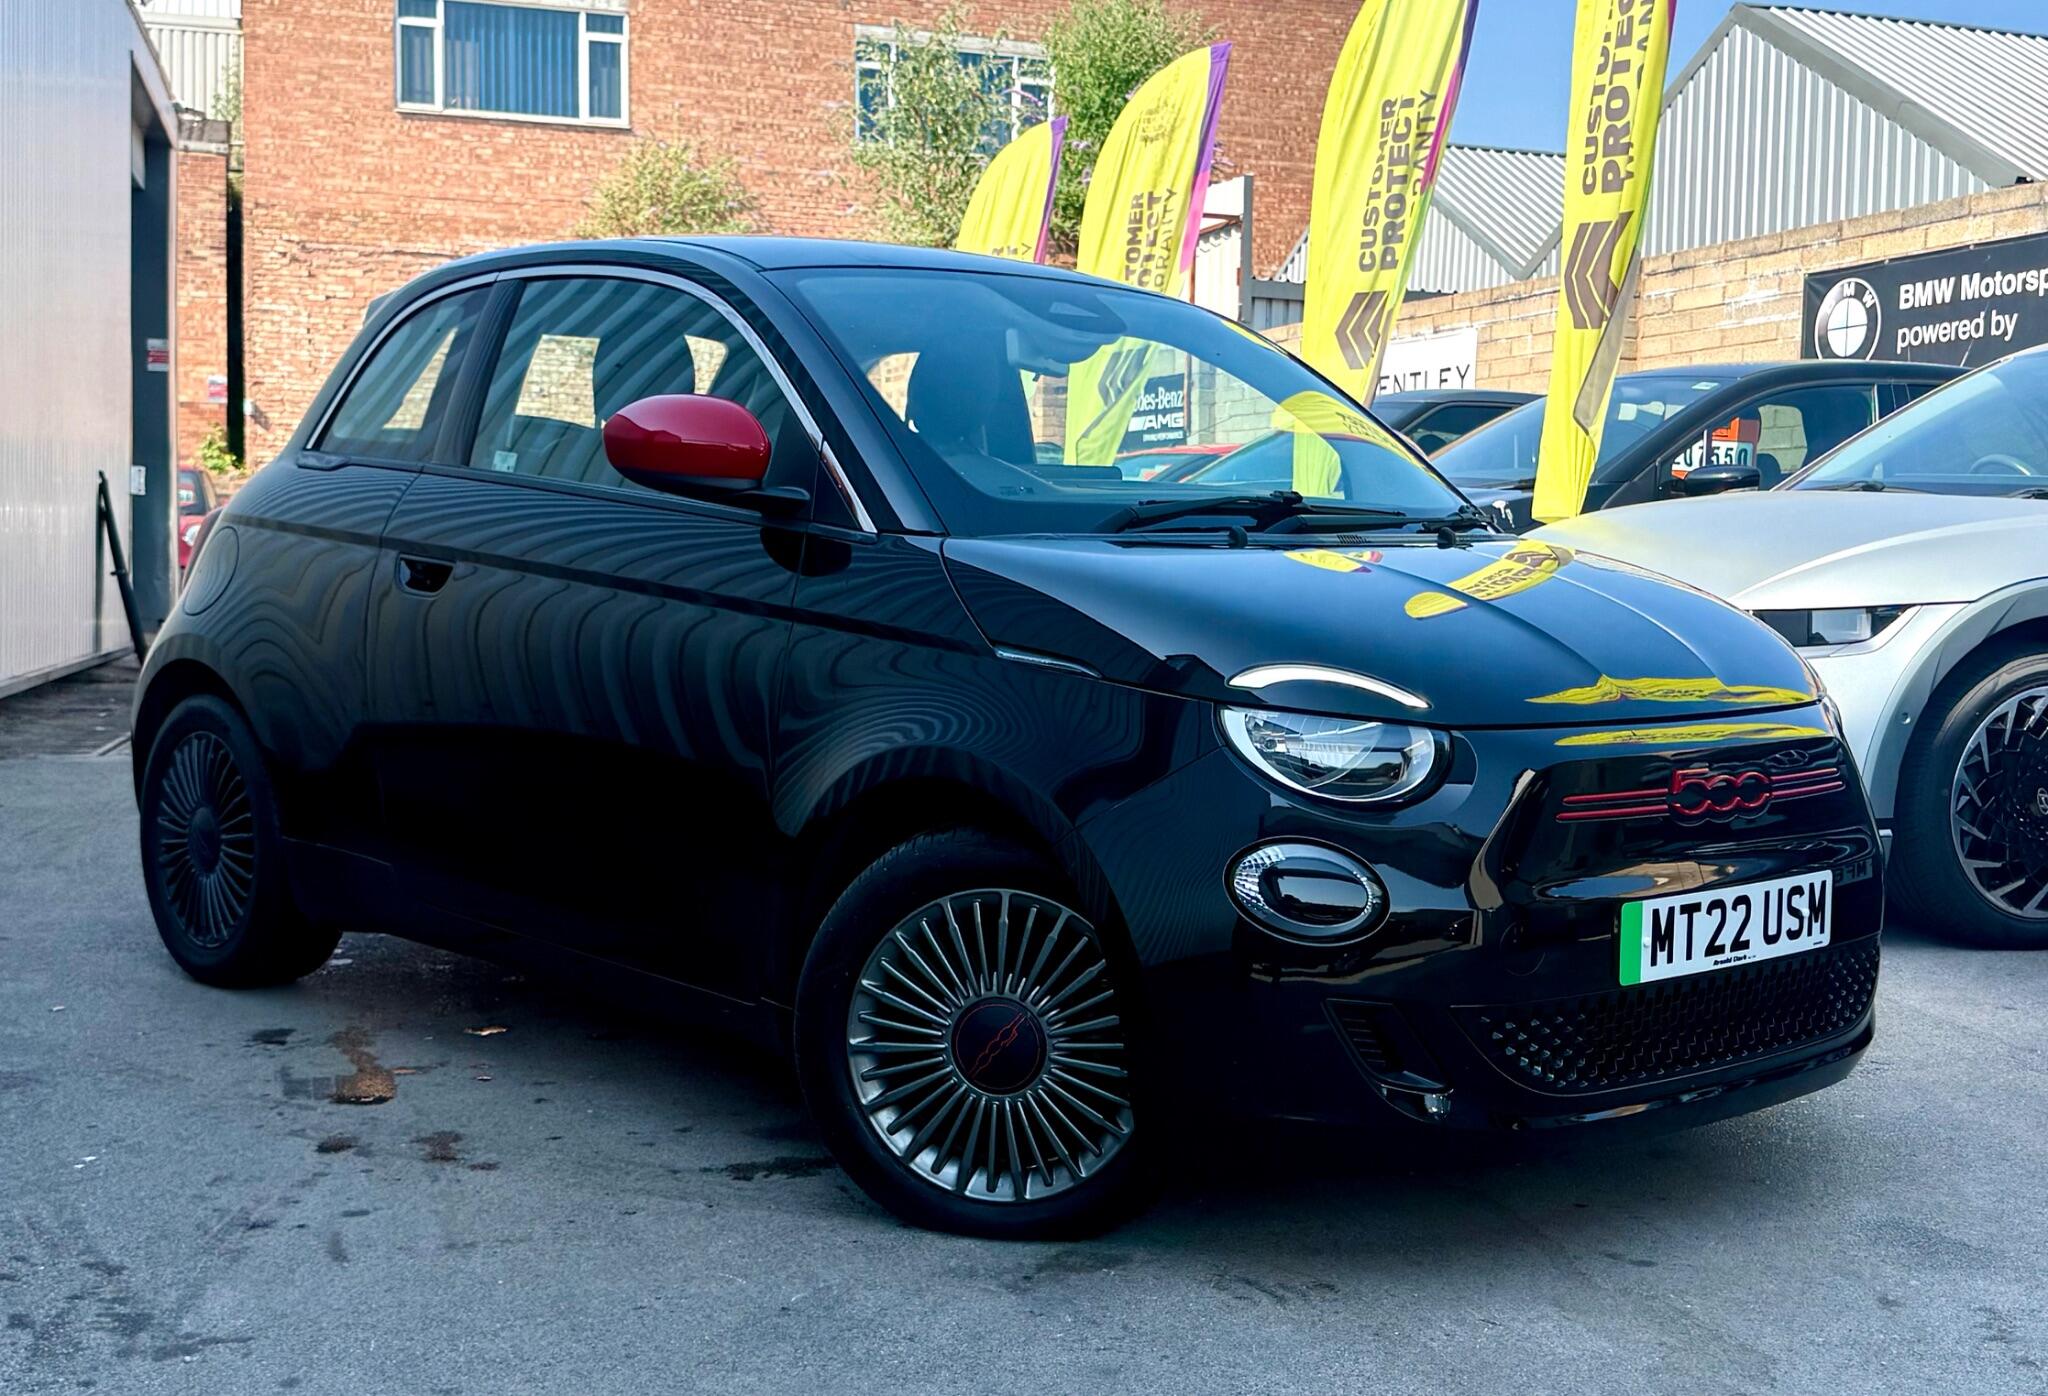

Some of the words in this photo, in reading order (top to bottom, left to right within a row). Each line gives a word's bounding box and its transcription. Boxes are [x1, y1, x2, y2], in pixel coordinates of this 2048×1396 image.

[1359, 98, 1397, 272] CUSTOMER
[1380, 97, 1414, 270] PROTECT
[1125, 193, 1144, 284] TOMER
[1898, 277, 1955, 310] BMW
[1896, 312, 1985, 355] powered
[1991, 310, 2019, 342] by
[1143, 412, 1184, 430] AMG
[1671, 767, 1770, 815] 500
[1650, 894, 1752, 967] MT22
[1762, 879, 1827, 946] USM
